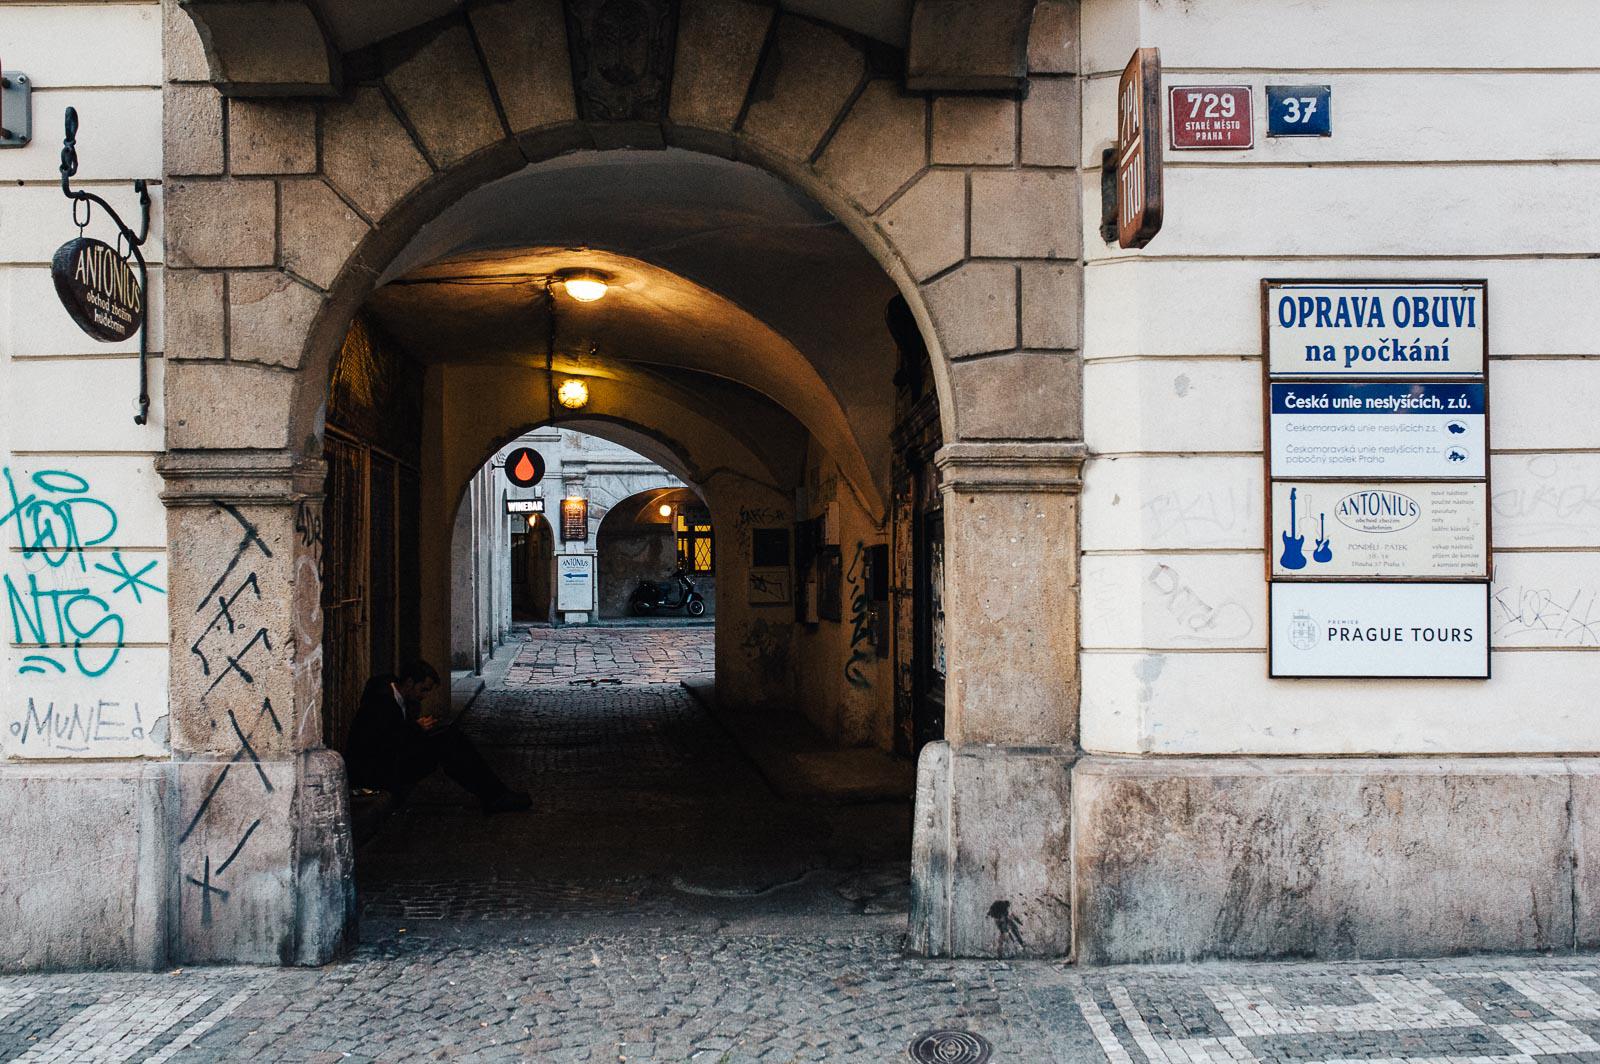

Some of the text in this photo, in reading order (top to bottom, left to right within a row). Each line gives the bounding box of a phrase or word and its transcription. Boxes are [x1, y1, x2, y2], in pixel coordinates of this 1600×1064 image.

[1187, 93, 1236, 118] 729
[1282, 97, 1317, 123] 37
[1185, 119, 1240, 130] STARÉ MĚSTO
[1195, 131, 1231, 140] PRAHA 1
[75, 245, 140, 314] ANTONIUS
[1278, 296, 1476, 328] OPRAVA OBUVI
[1305, 337, 1450, 368] na počkání
[1284, 392, 1471, 411] Česká unie neslyšících, z.ú.
[1285, 423, 1356, 433] Českomoravská
[1357, 424, 1376, 433] unie
[1285, 444, 1356, 454] Českomoravská
[1357, 445, 1376, 454] unie
[1286, 455, 1385, 464] pobočný spolek Praha
[507, 501, 543, 512] WINEBAR
[1339, 492, 1416, 516] ANTONIUS
[1328, 628, 1473, 641] PRAGUE TOURS
